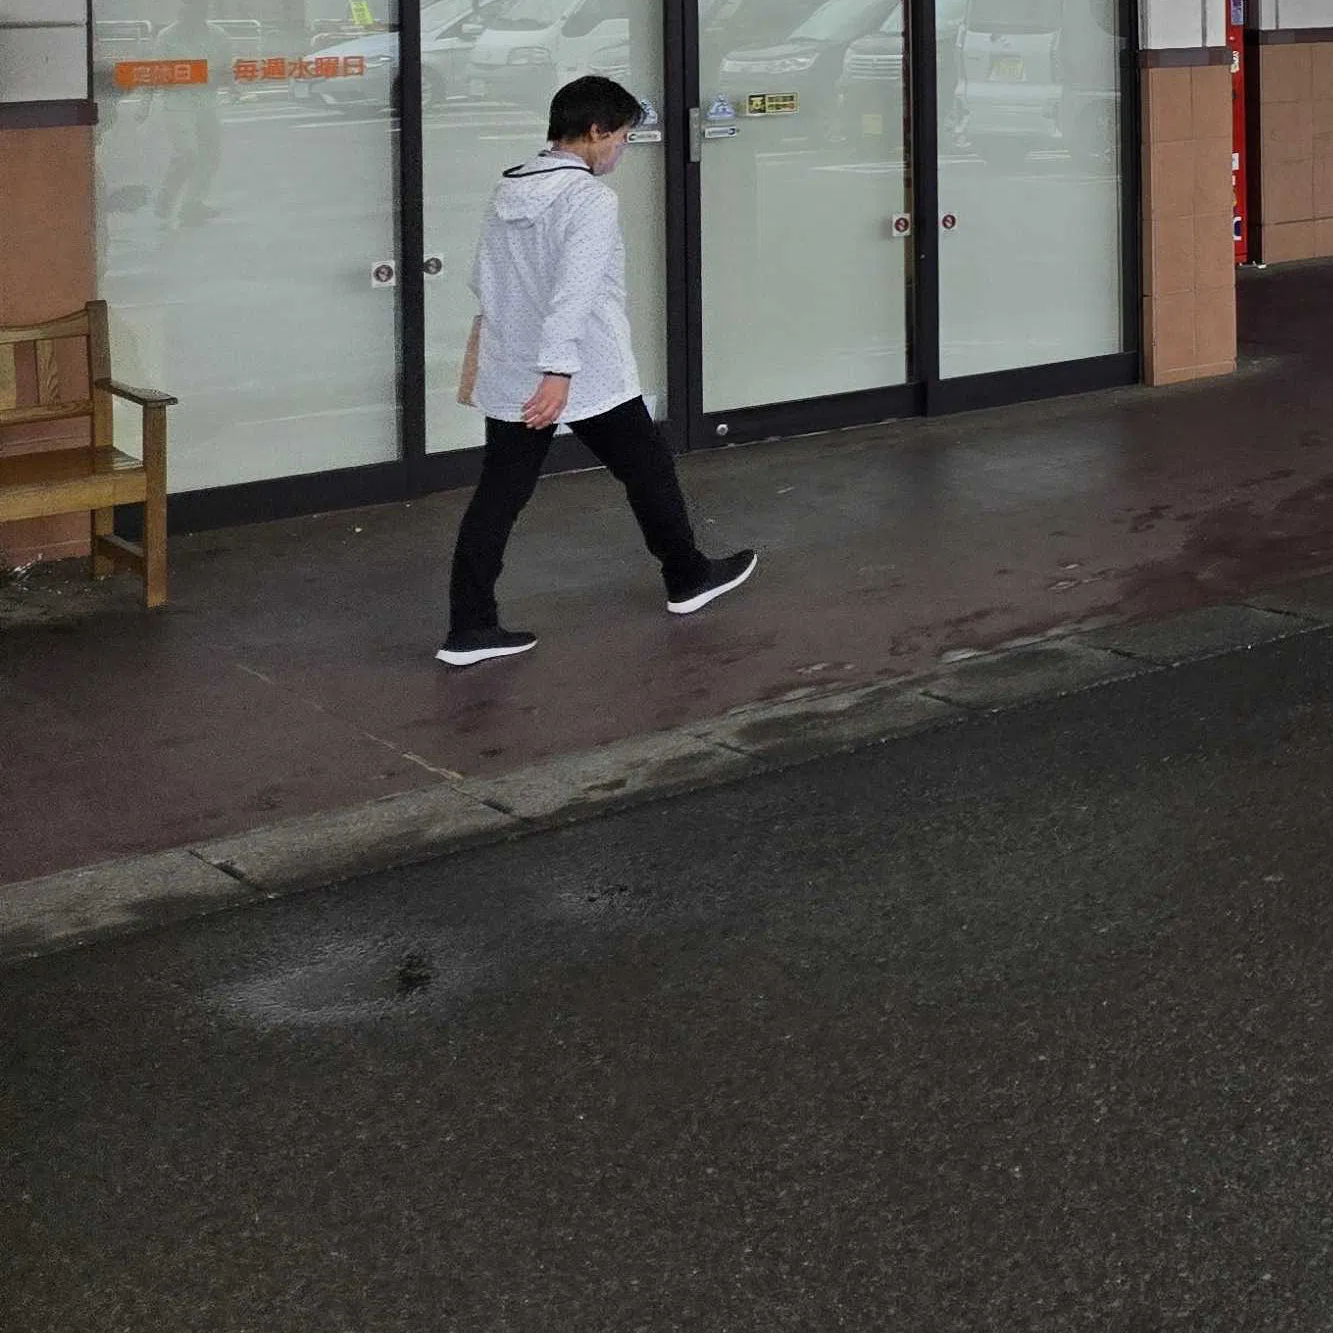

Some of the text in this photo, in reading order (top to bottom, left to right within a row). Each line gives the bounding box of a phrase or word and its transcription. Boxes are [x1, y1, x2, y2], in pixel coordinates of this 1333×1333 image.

[233, 55, 367, 82] 毎週水曜日
